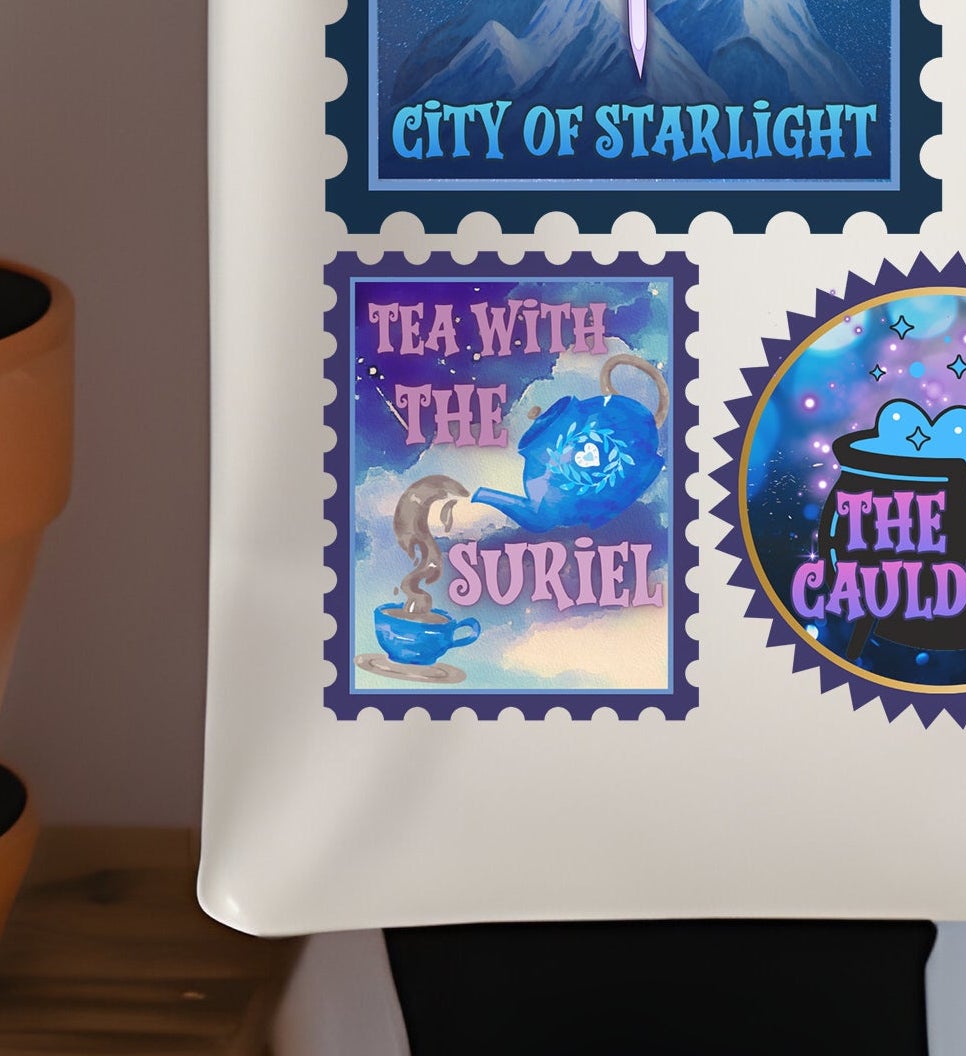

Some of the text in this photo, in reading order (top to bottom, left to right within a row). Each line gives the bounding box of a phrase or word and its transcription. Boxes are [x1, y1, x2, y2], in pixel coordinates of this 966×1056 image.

[524, 105, 584, 157] OF
[368, 301, 460, 356] TEA
[395, 383, 508, 447] THE
[836, 490, 948, 554] THE
